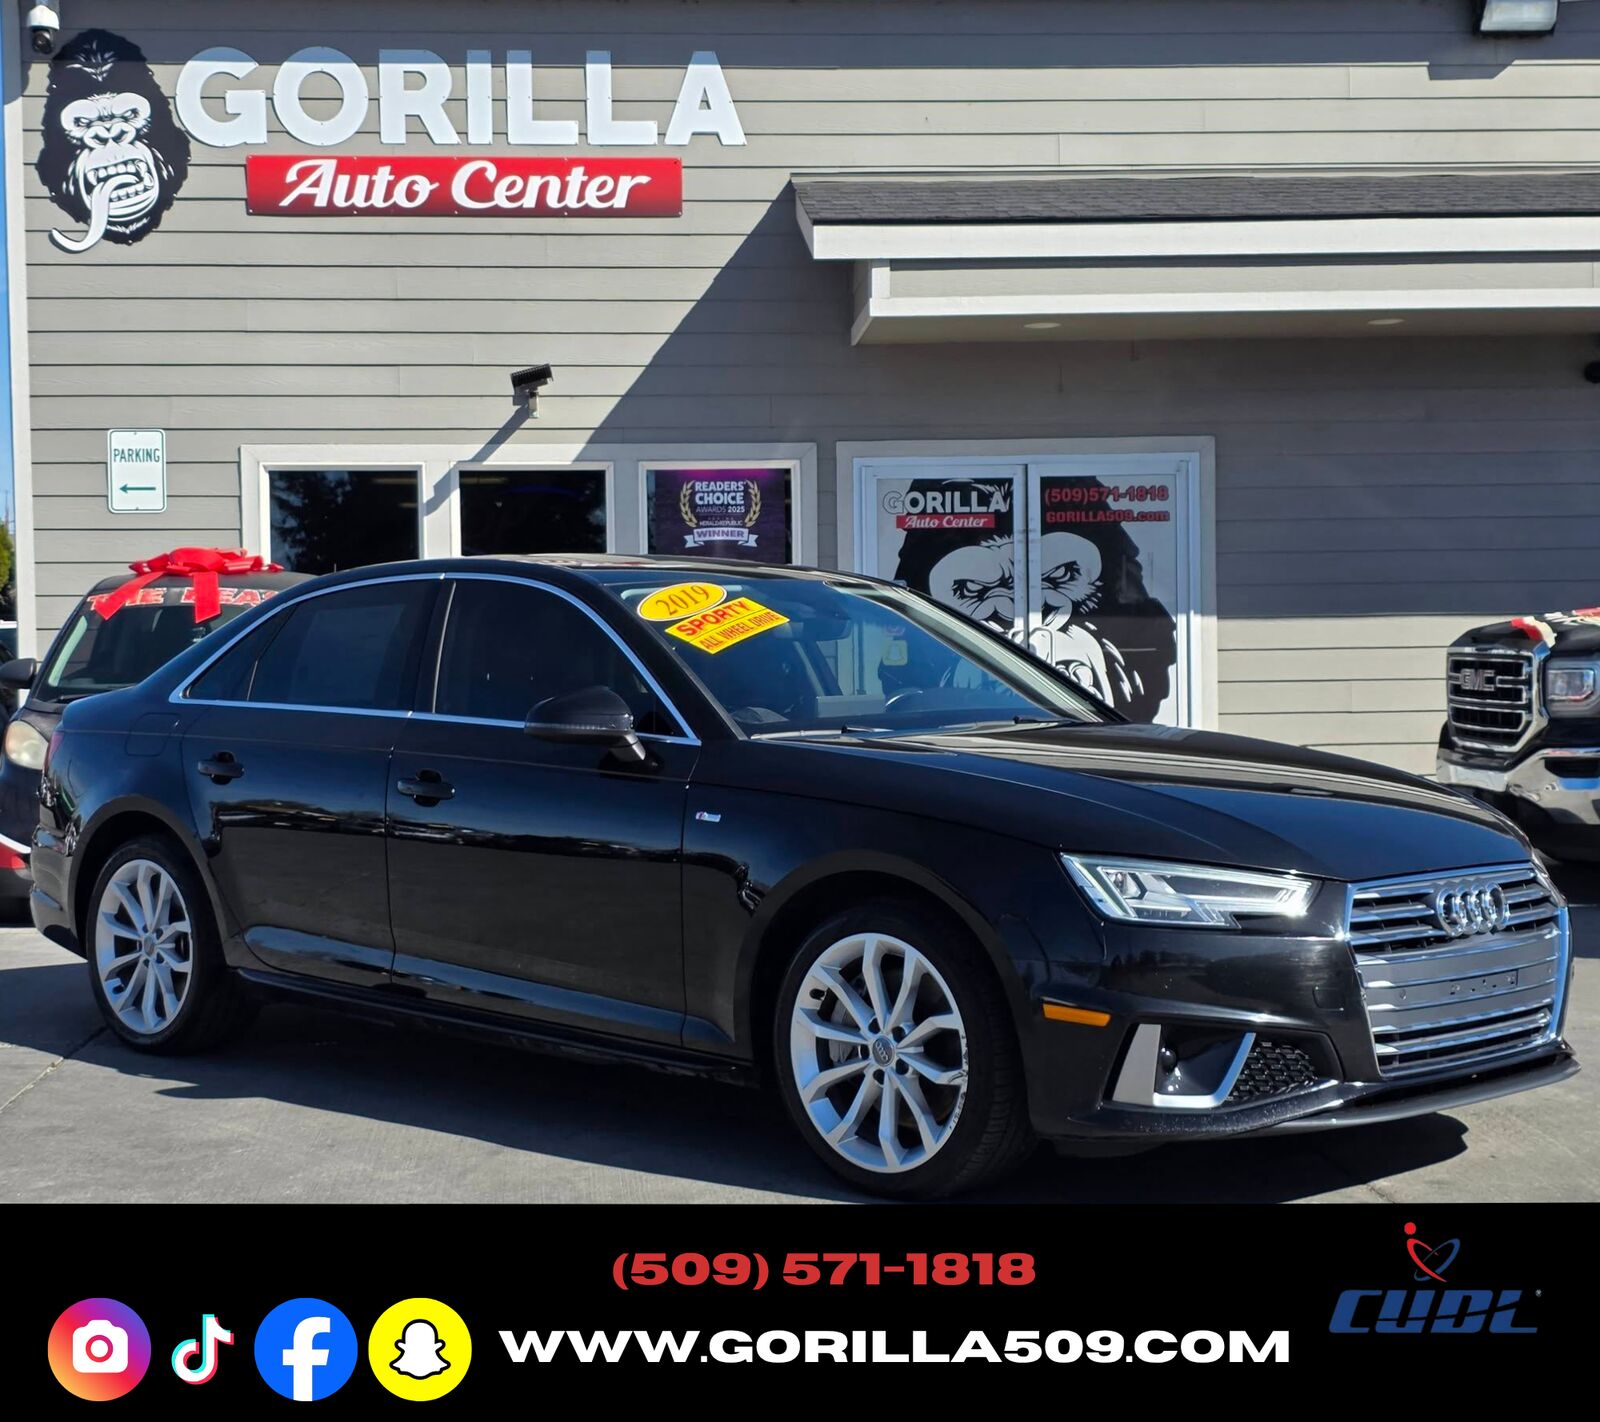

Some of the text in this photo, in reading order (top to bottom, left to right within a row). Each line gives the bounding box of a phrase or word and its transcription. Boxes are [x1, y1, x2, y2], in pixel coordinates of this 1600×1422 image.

[175, 46, 748, 147] GORILLA
[278, 158, 652, 209] Auto Center
[113, 448, 161, 463] PARKING
[695, 481, 747, 491] READERS'
[1044, 484, 1170, 507] (509)571-1818
[695, 492, 744, 505] CHOICE
[696, 505, 746, 513] AWARDS 2025
[882, 490, 1007, 515] GORILLA
[904, 515, 988, 529] Auto Center
[1045, 508, 1171, 524] GORILLA509.com
[696, 529, 745, 539] WINNER
[87, 587, 167, 611] TE
[655, 584, 710, 616] 2019
[676, 600, 752, 636] SPORTY
[699, 611, 781, 650] ALL WHEEL DRIVE
[1460, 669, 1496, 691] GMC
